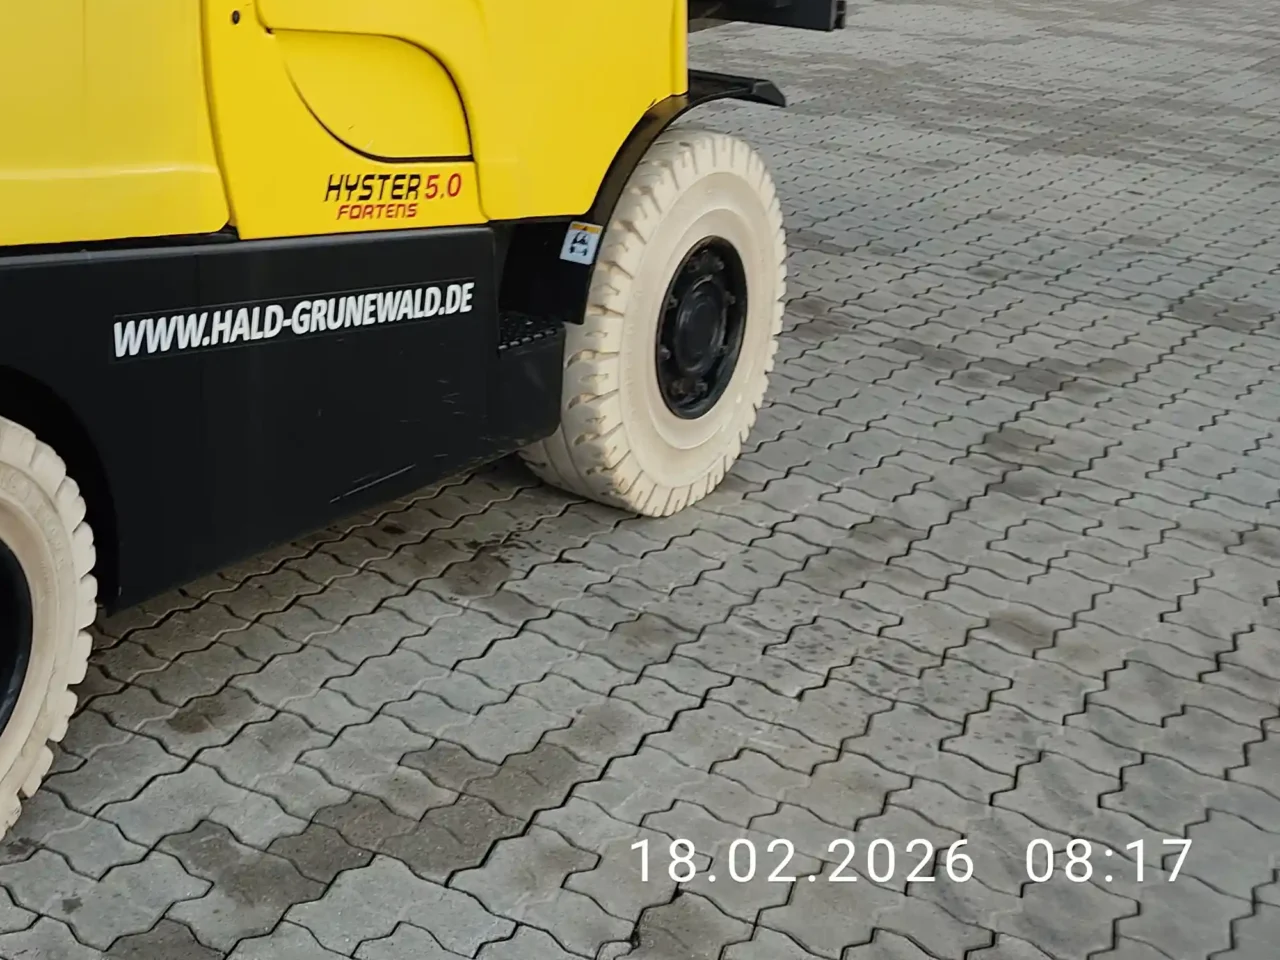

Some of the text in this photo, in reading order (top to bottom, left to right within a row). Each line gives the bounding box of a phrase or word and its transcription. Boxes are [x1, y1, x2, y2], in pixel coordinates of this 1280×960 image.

[324, 173, 463, 203] HYSTER 5.0
[336, 203, 419, 221] FORTENS
[113, 282, 475, 358] WWW.HALD-GRUNEWALD.DE
